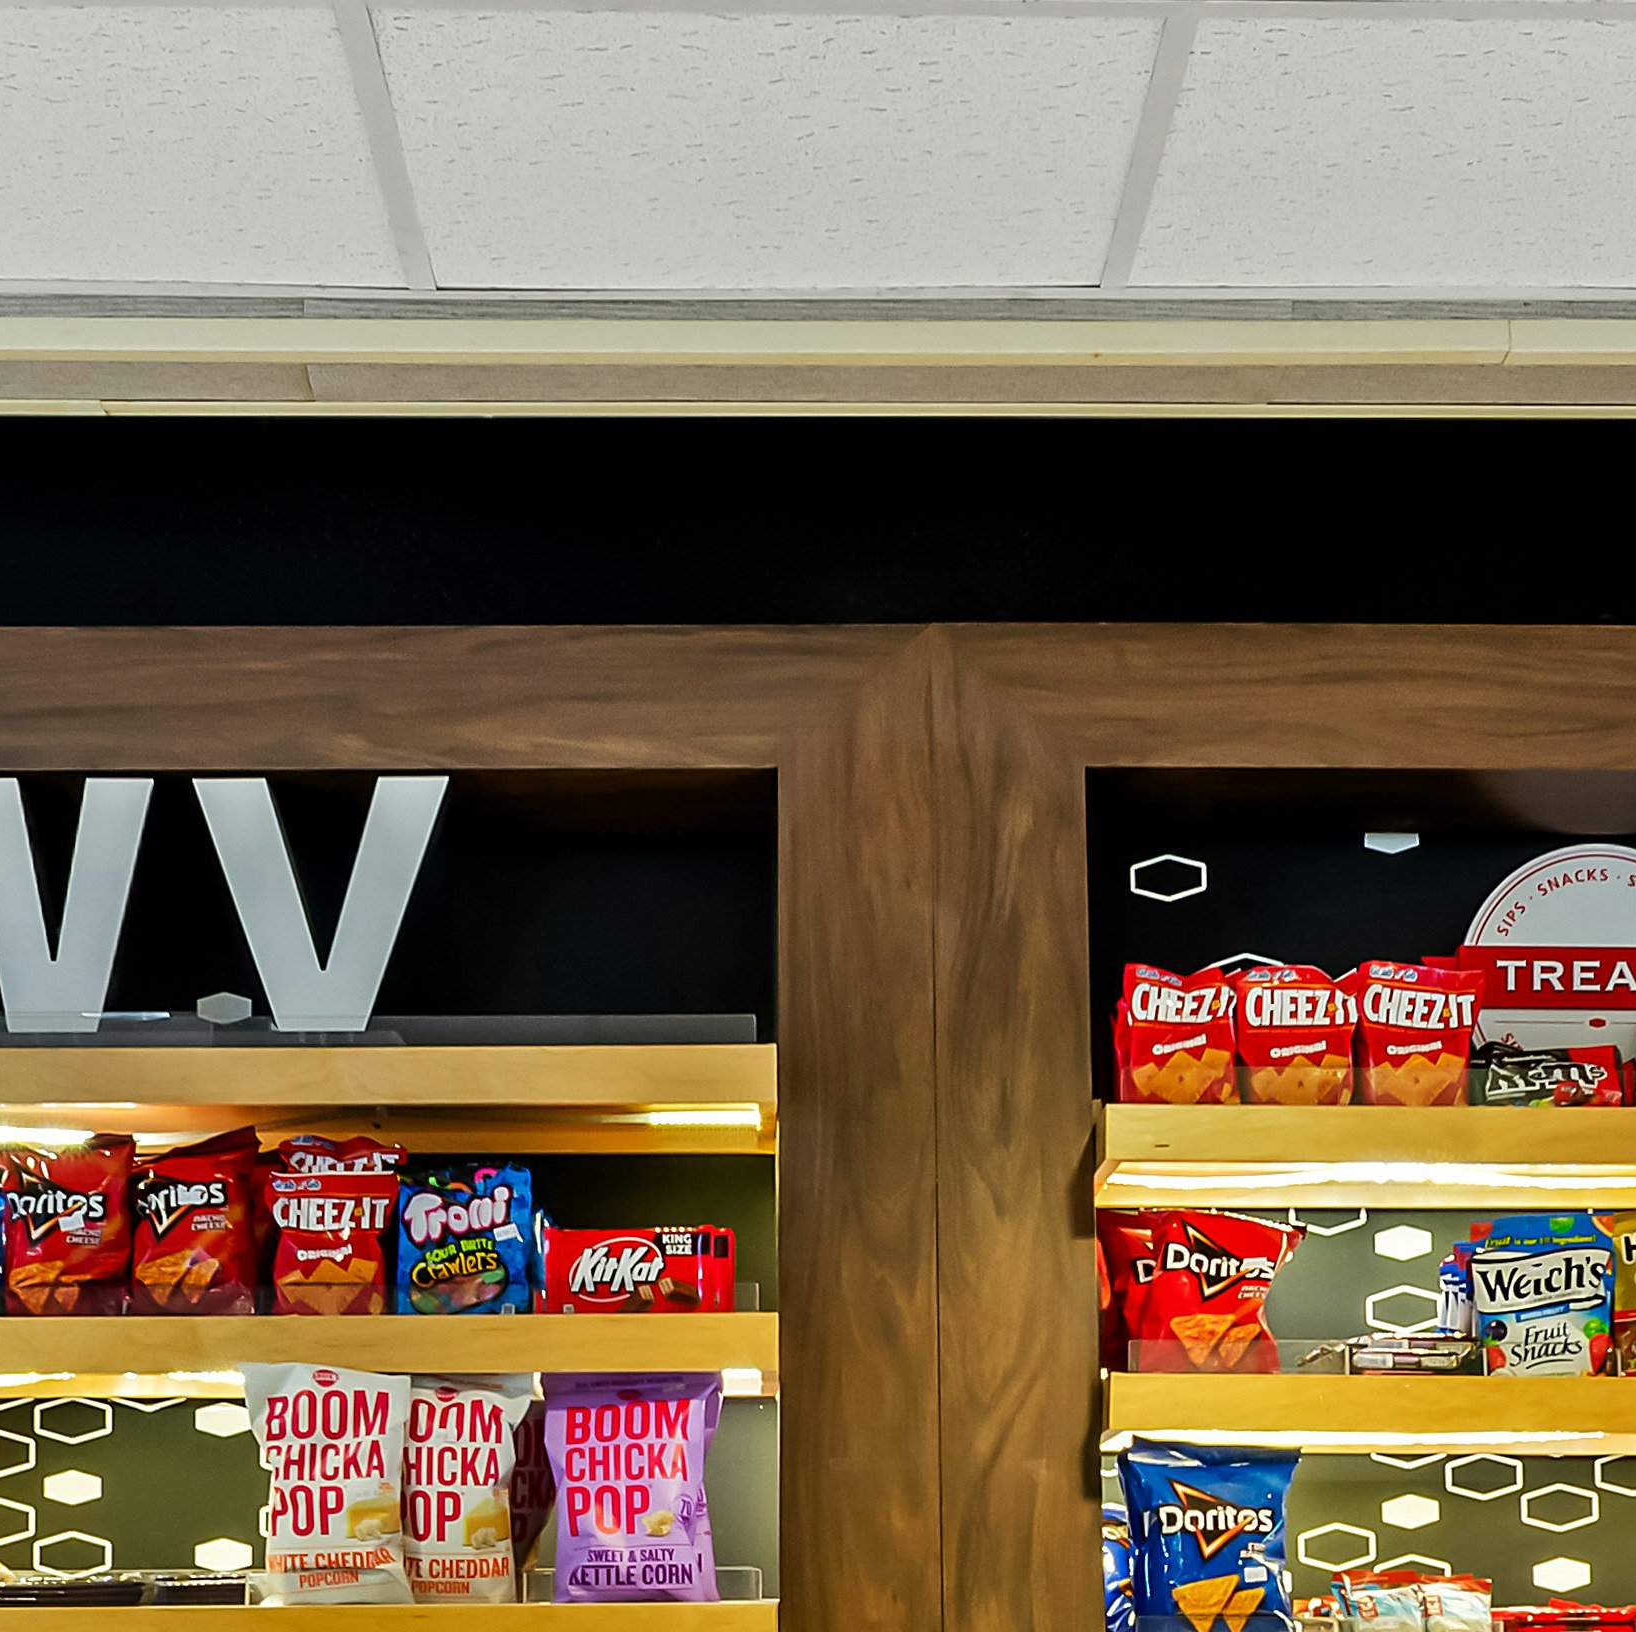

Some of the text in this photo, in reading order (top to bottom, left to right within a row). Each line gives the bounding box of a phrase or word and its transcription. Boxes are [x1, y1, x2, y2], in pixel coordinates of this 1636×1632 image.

[1497, 901, 1526, 936] SIPS
[1537, 868, 1609, 897] SNACKS
[404, 1187, 511, 1243] Trolli
[662, 1233, 693, 1245] KING
[665, 1245, 693, 1256] SIZE
[412, 1251, 499, 1287] Crawlers
[1509, 1337, 1583, 1369] Snacks
[1524, 1322, 1570, 1347] Fruit
[266, 1389, 390, 1442] BOOM
[408, 1398, 504, 1444] OOM
[566, 1398, 692, 1445] BOOM
[266, 1440, 385, 1482] CHICKA
[403, 1446, 499, 1487] HICKA
[565, 1442, 688, 1483] CHICKA
[271, 1484, 344, 1537] POP
[403, 1490, 462, 1543] OP
[567, 1485, 650, 1537] POP
[1159, 1505, 1274, 1535] Doritos
[428, 1556, 509, 1579] CHEDDAR
[569, 1563, 693, 1586] KETTLE CORN
[587, 1549, 675, 1563] SWEET & SALTY
[299, 1570, 359, 1589] POPCORN
[411, 1580, 470, 1596] POPCORN
